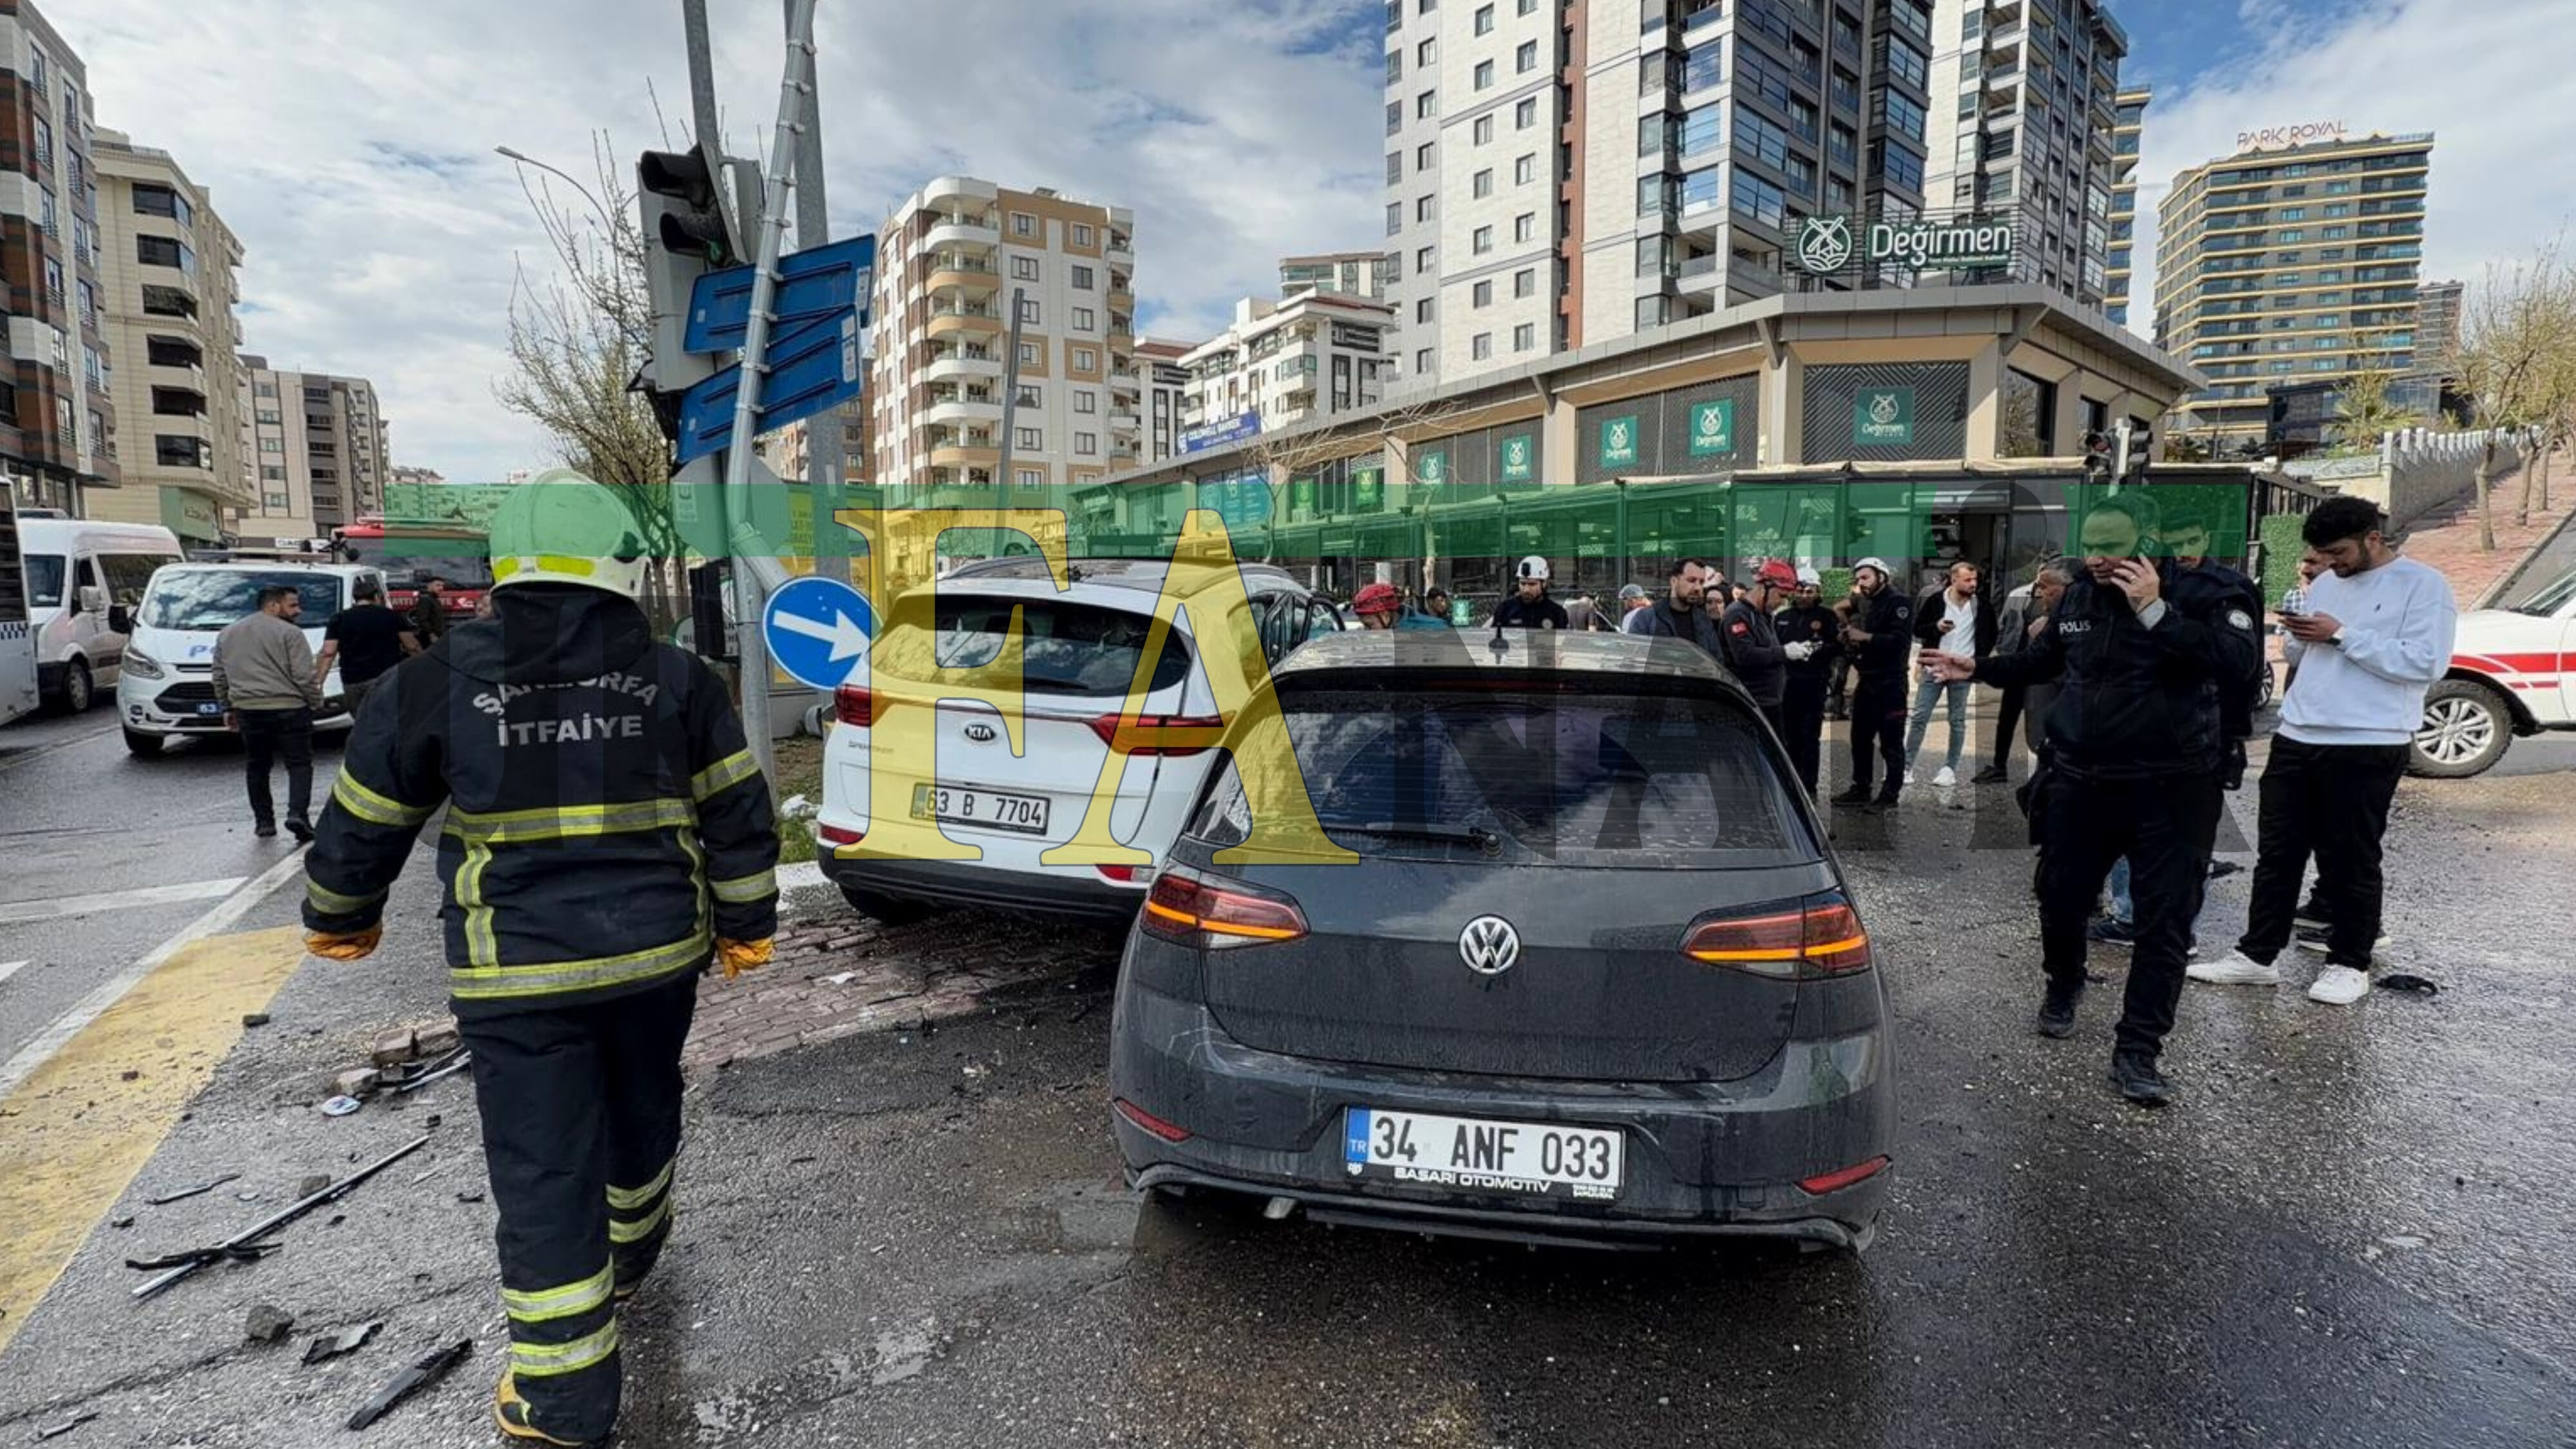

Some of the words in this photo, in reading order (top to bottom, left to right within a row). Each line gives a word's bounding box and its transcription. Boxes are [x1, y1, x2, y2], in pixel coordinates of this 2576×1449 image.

[2237, 127, 2286, 147] PARK
[2290, 120, 2348, 140] ROYAL
[1871, 223, 2010, 266] Değirmen
[473, 672, 659, 715] ŞARFA
[498, 712, 643, 747] İTFAİYE
[927, 790, 949, 813] 63
[963, 793, 974, 816] B
[996, 797, 1041, 825] 7704
[1350, 1139, 1367, 1153] TR
[1374, 1116, 1417, 1162] 34
[1450, 1124, 1520, 1171] ANF
[1542, 1132, 1611, 1180] 033
[1460, 1174, 1551, 1193] OTOMOTIV
